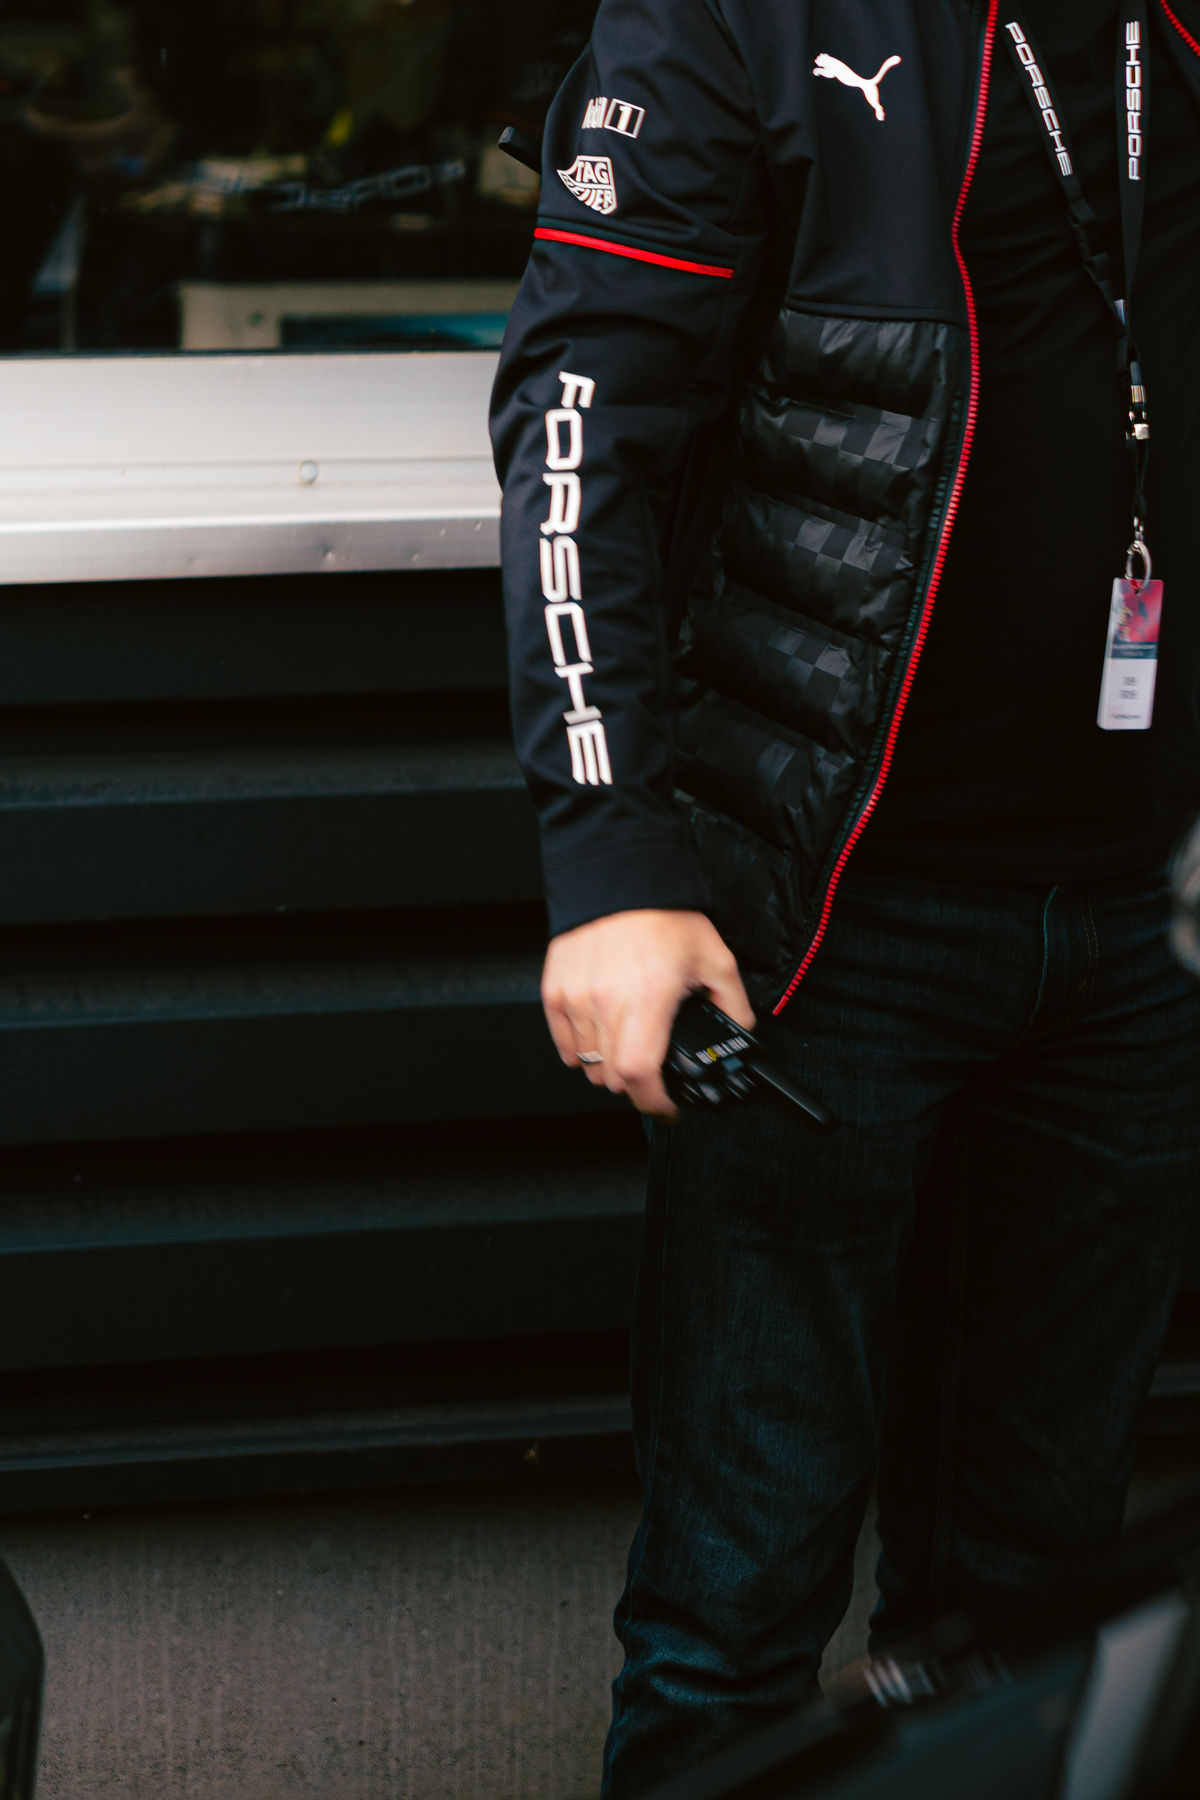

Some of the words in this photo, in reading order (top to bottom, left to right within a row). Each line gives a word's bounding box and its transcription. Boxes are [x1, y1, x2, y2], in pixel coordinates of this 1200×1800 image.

[574, 161, 610, 184] TAG
[1005, 21, 1073, 177] PORSCHE
[1125, 20, 1143, 181] PORSCHE
[539, 370, 613, 786] PORSCHE
